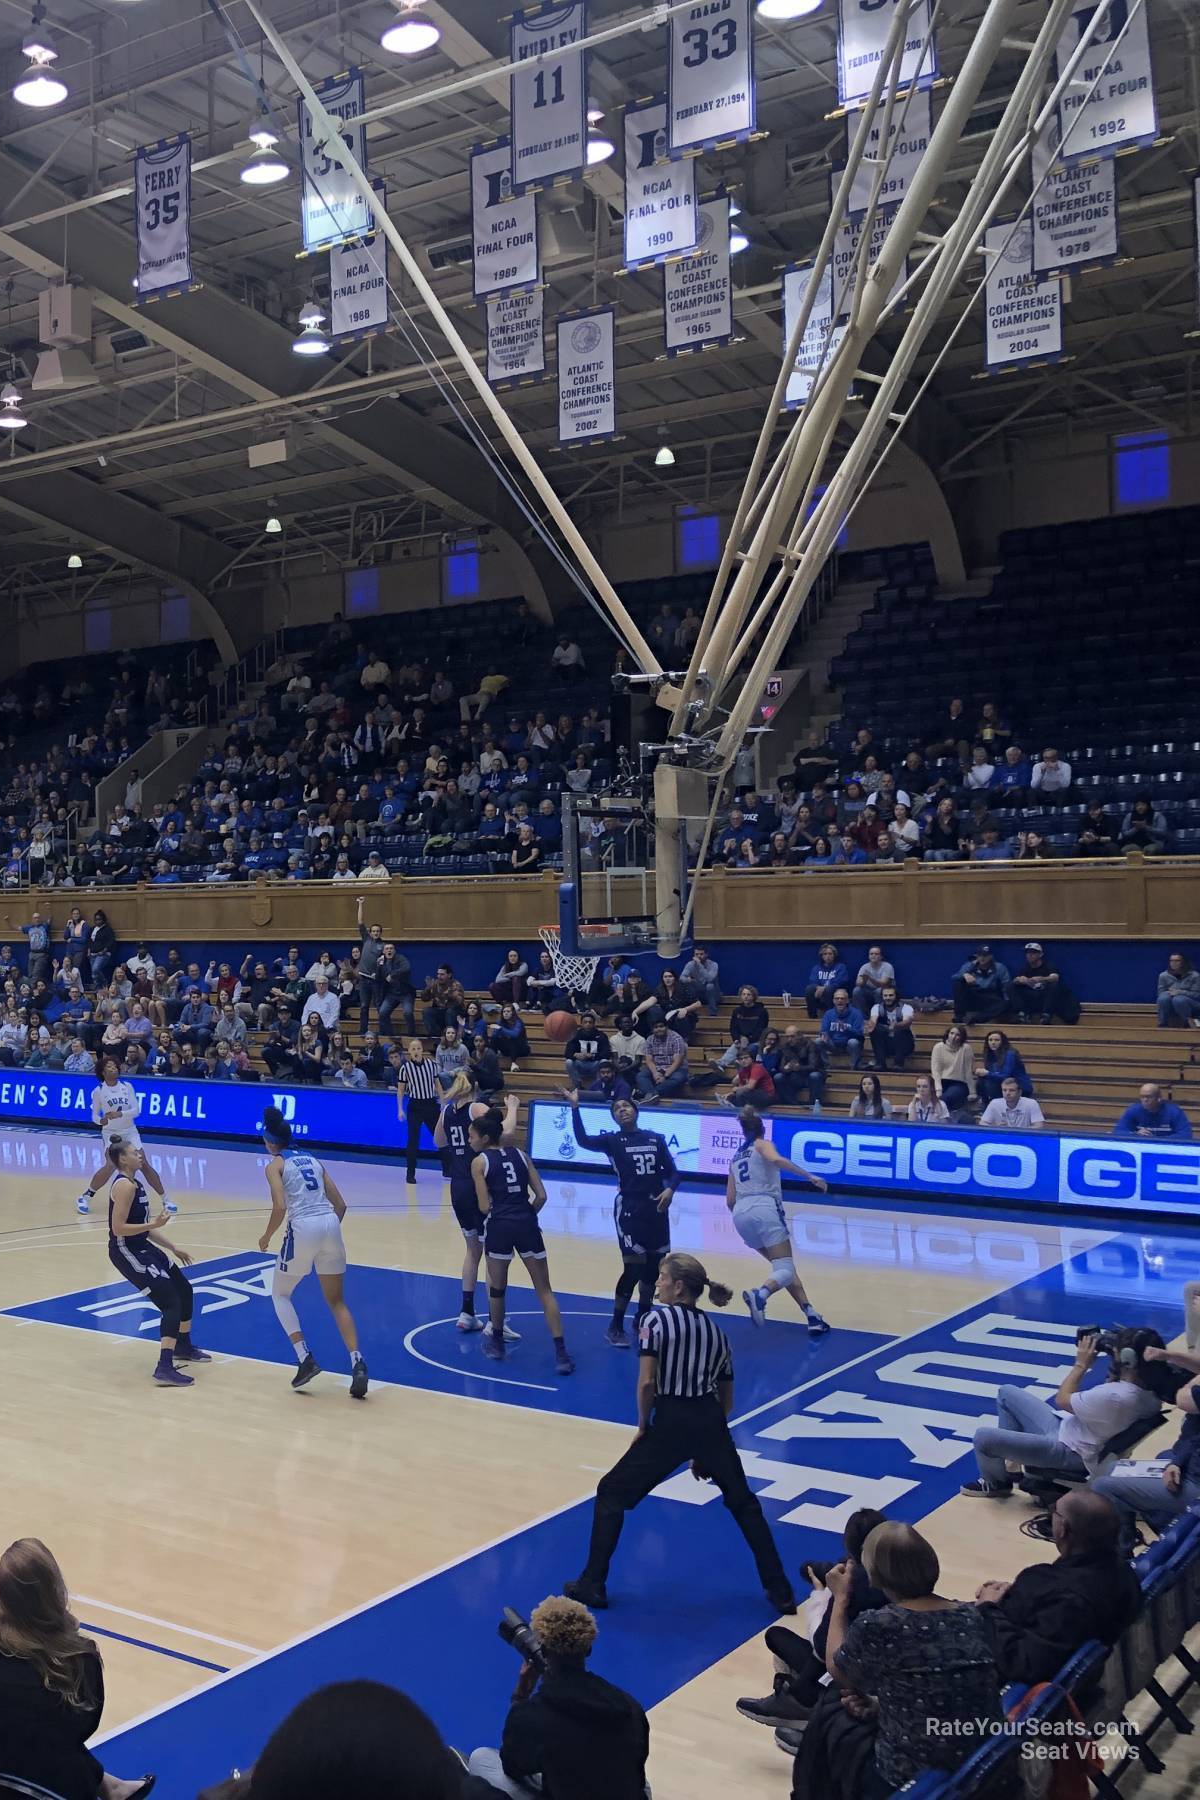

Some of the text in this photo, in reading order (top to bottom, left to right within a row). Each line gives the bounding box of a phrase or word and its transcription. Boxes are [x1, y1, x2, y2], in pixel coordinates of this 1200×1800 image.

[683, 18, 737, 68] 33
[533, 65, 564, 108] 11
[1109, 76, 1148, 100] FOUR
[676, 101, 714, 121] FEBRUARY
[1090, 118, 1126, 139] 1992
[145, 165, 181, 194] FERRY
[1046, 164, 1100, 186] ATLANTIC
[643, 178, 672, 196] NCAA
[1055, 181, 1092, 199] COAST
[145, 191, 180, 231] 35
[629, 194, 691, 220] FINAL FOUR
[1036, 191, 1113, 217] CONFERENCE
[491, 218, 517, 234] NCAA
[1039, 206, 1109, 231] CHAMPIONS
[477, 232, 534, 256] FINAL FOUR
[647, 230, 673, 247] 1990
[1057, 241, 1091, 258] 1978
[346, 263, 369, 278] NCAA
[493, 266, 517, 281] 1989
[674, 254, 719, 274] ATLANTIC
[682, 268, 711, 284] COAST
[334, 277, 384, 299] FINAL FOUR
[667, 277, 729, 301] CONFERENCE
[496, 296, 533, 313] ATLANTIC
[670, 292, 726, 312] CHAMPIONS
[988, 293, 1058, 317] CONFERENCE
[349, 309, 370, 322] 1988
[502, 309, 527, 323] COAST
[992, 307, 1055, 329] CHAMPIONS
[490, 318, 541, 337] CONFERENCE
[686, 322, 712, 337] 1965
[491, 331, 538, 348] CHAMPIONS
[1010, 339, 1039, 353] 2004
[503, 359, 526, 370] 1964
[568, 361, 604, 376] ATLANTIC
[573, 373, 599, 386] COAST
[561, 382, 613, 400] CONFERENCE
[563, 393, 611, 410] CHAMPIONS
[575, 420, 598, 432] 2002
[60, 1086, 207, 1120] BATBALL
[450, 1126, 465, 1146] 21
[633, 1154, 656, 1175] 32
[791, 1131, 1037, 1189] GEICO
[301, 1168, 319, 1191] 5
[502, 1161, 517, 1183] 3
[738, 1160, 749, 1183] 2
